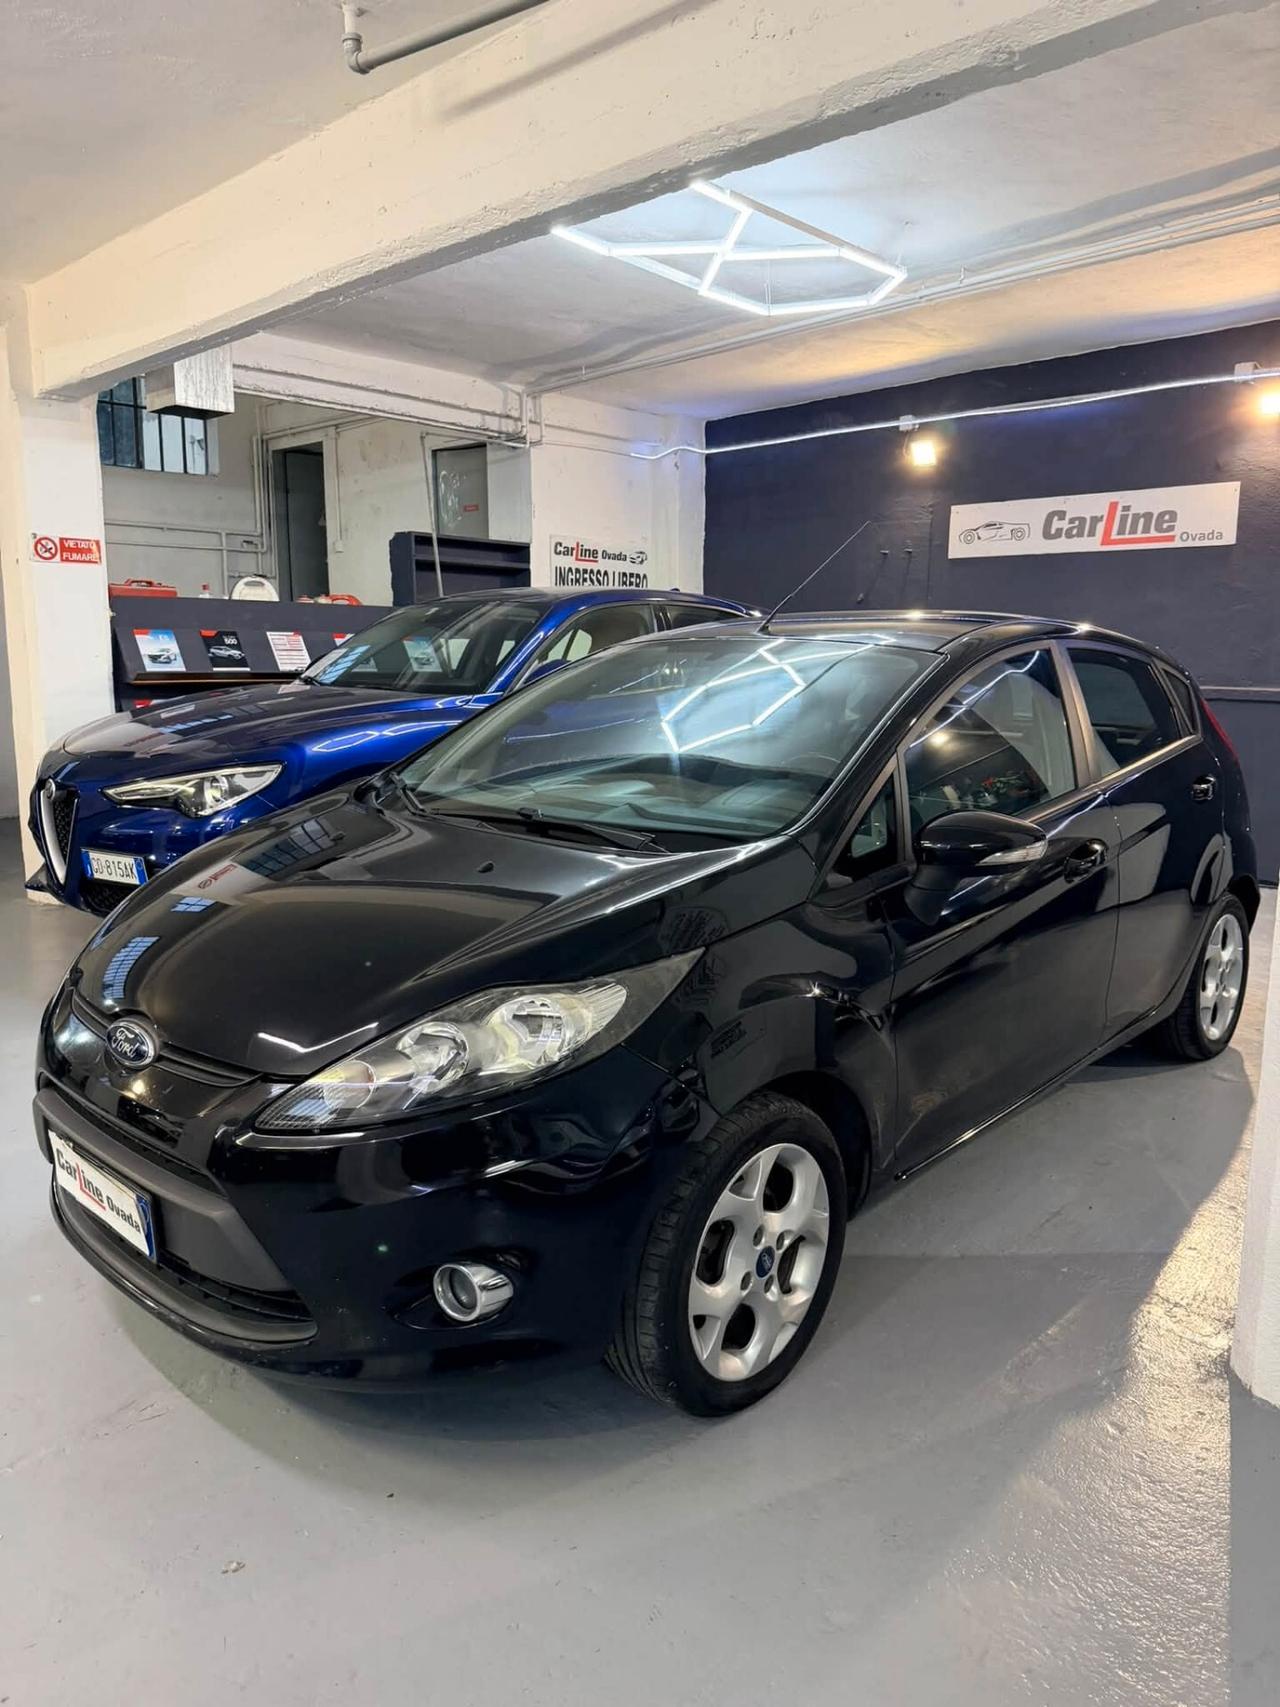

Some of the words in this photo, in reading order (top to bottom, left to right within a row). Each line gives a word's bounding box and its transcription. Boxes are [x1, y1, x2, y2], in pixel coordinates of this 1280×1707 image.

[1042, 501, 1178, 546] CarLine
[1180, 529, 1223, 543] Ovada
[63, 539, 96, 549] VIETATO
[554, 541, 599, 563] CarLine
[601, 550, 627, 562] Ovada
[63, 551, 99, 561] FUMARE
[555, 565, 609, 587] INGRESSO
[111, 1027, 140, 1058] Ford
[57, 1148, 107, 1212] CarLine
[106, 1194, 142, 1234] Ovada
